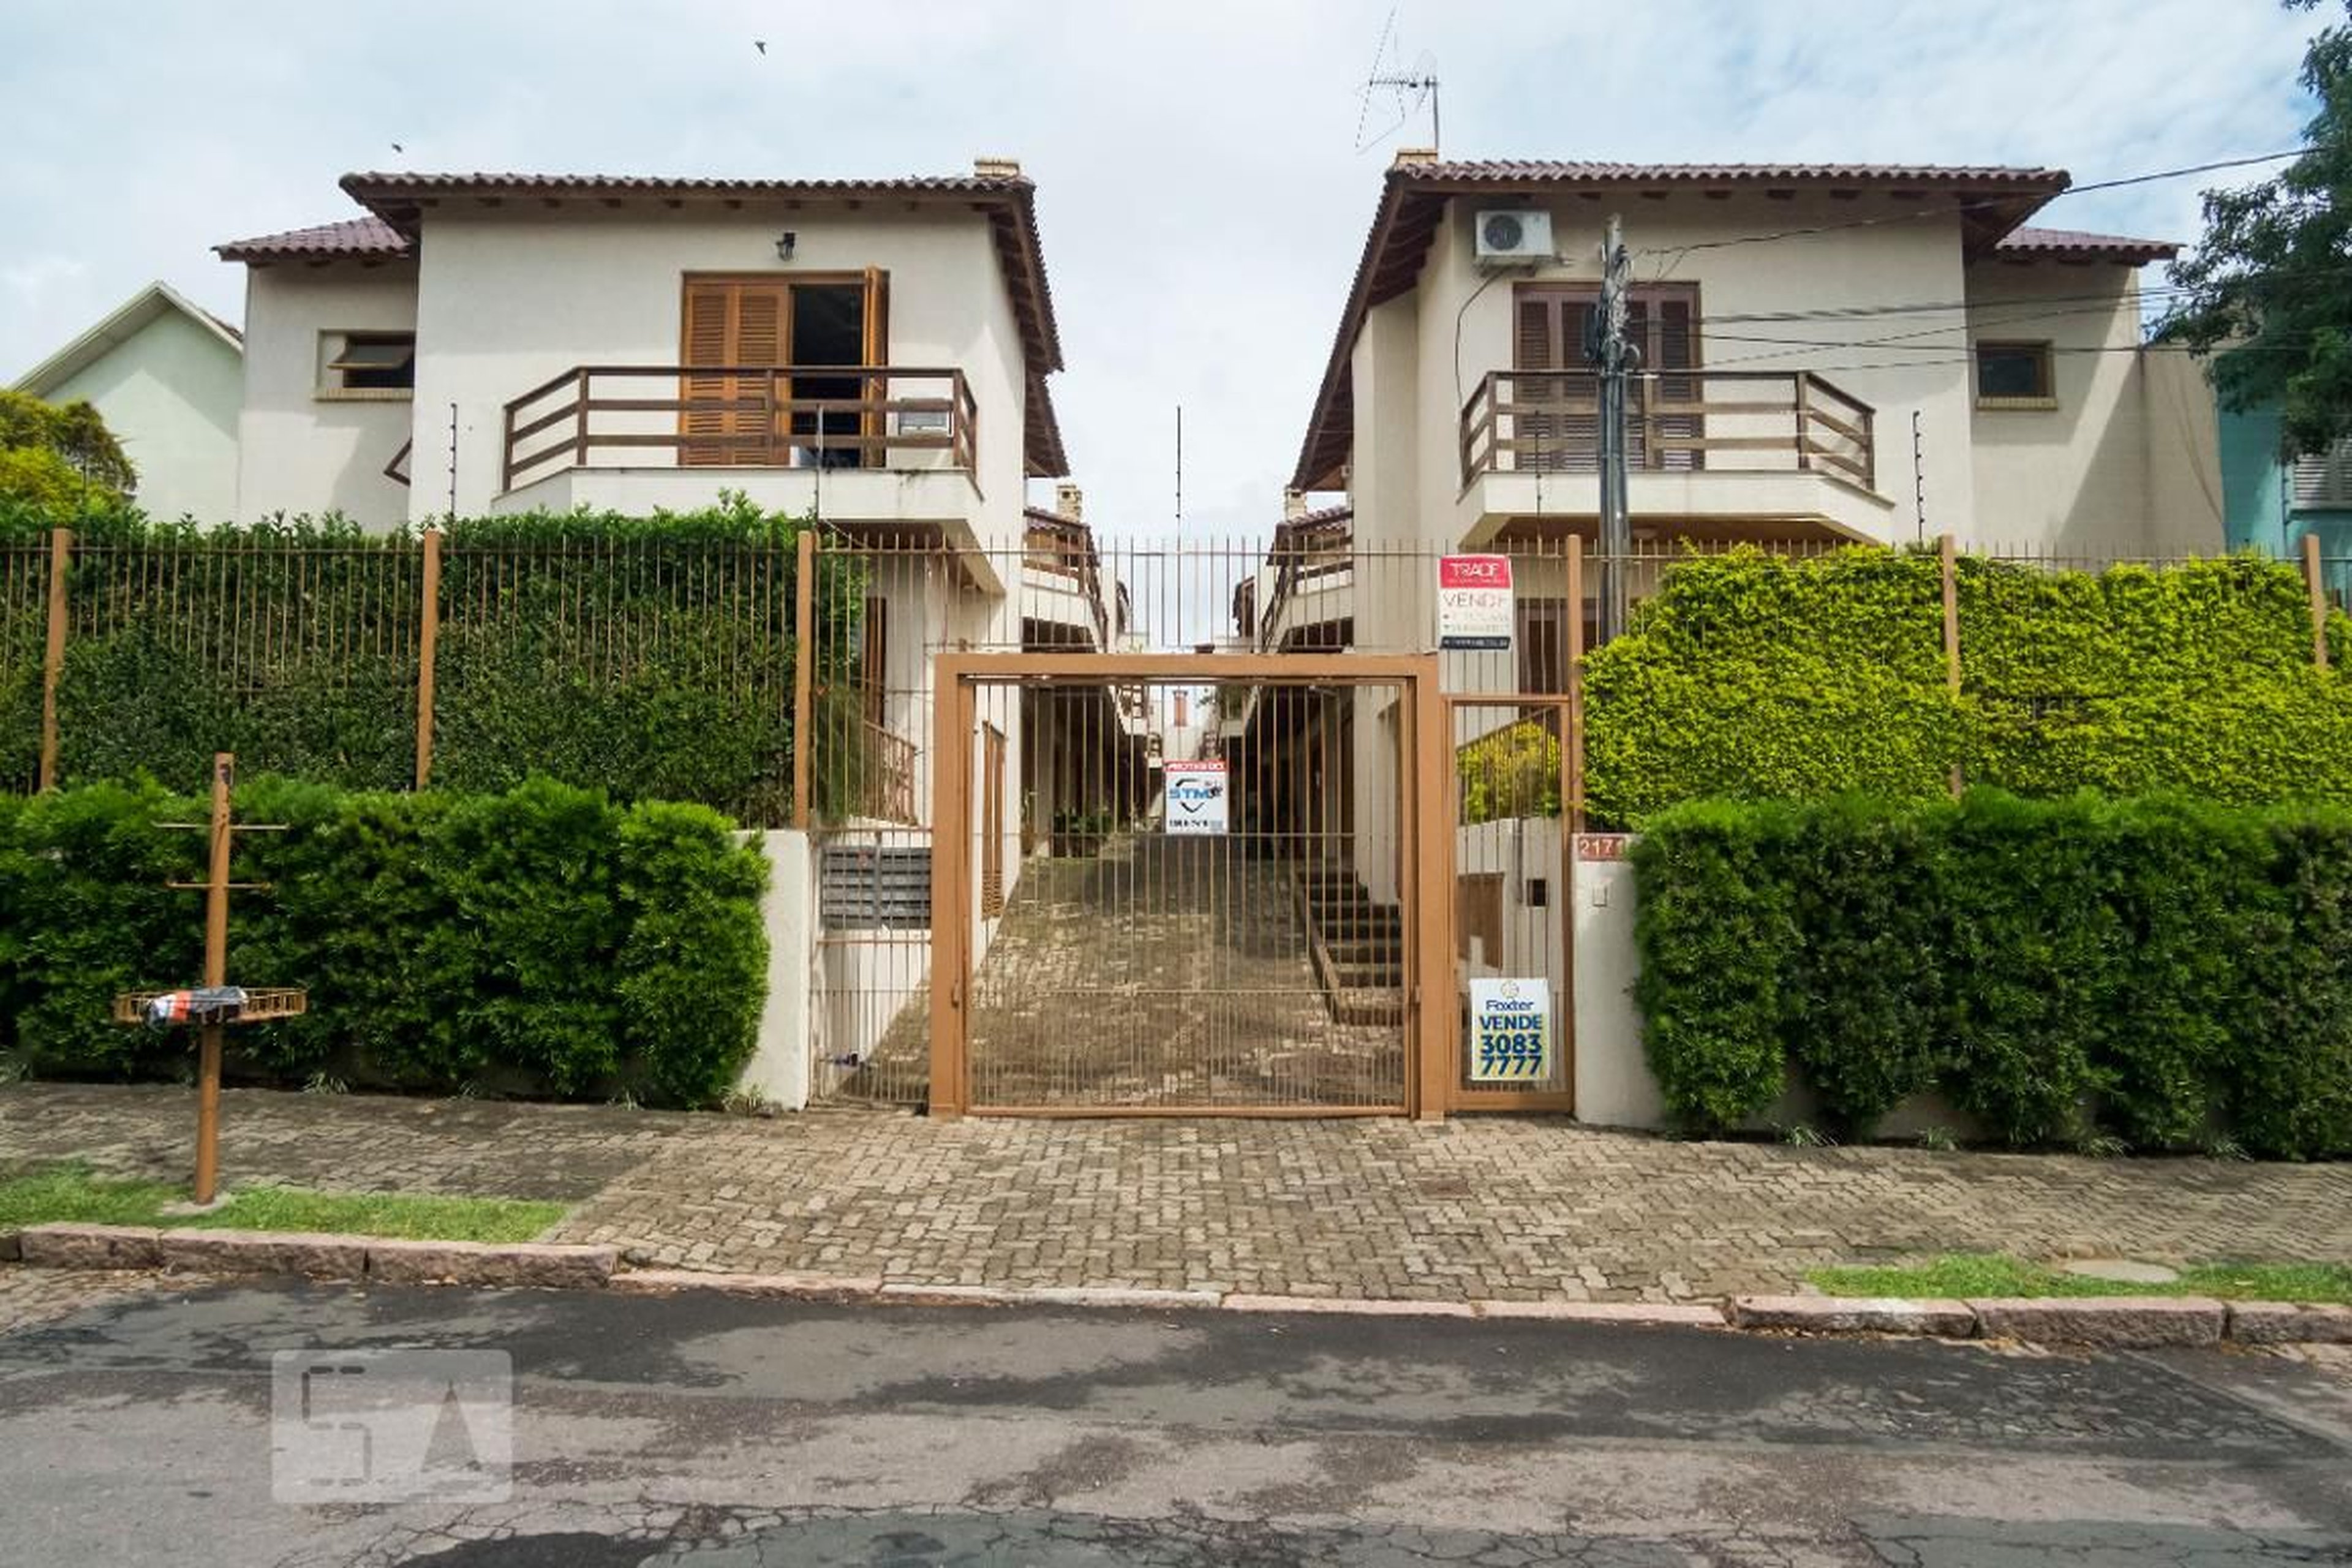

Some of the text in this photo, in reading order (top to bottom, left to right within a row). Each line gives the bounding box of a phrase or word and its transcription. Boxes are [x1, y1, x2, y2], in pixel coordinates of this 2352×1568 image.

[1486, 1000, 1534, 1011] Foxter
[1479, 1014, 1542, 1030] VENDE
[1480, 1033, 1542, 1054] 3083
[1480, 1055, 1542, 1075] 7777
